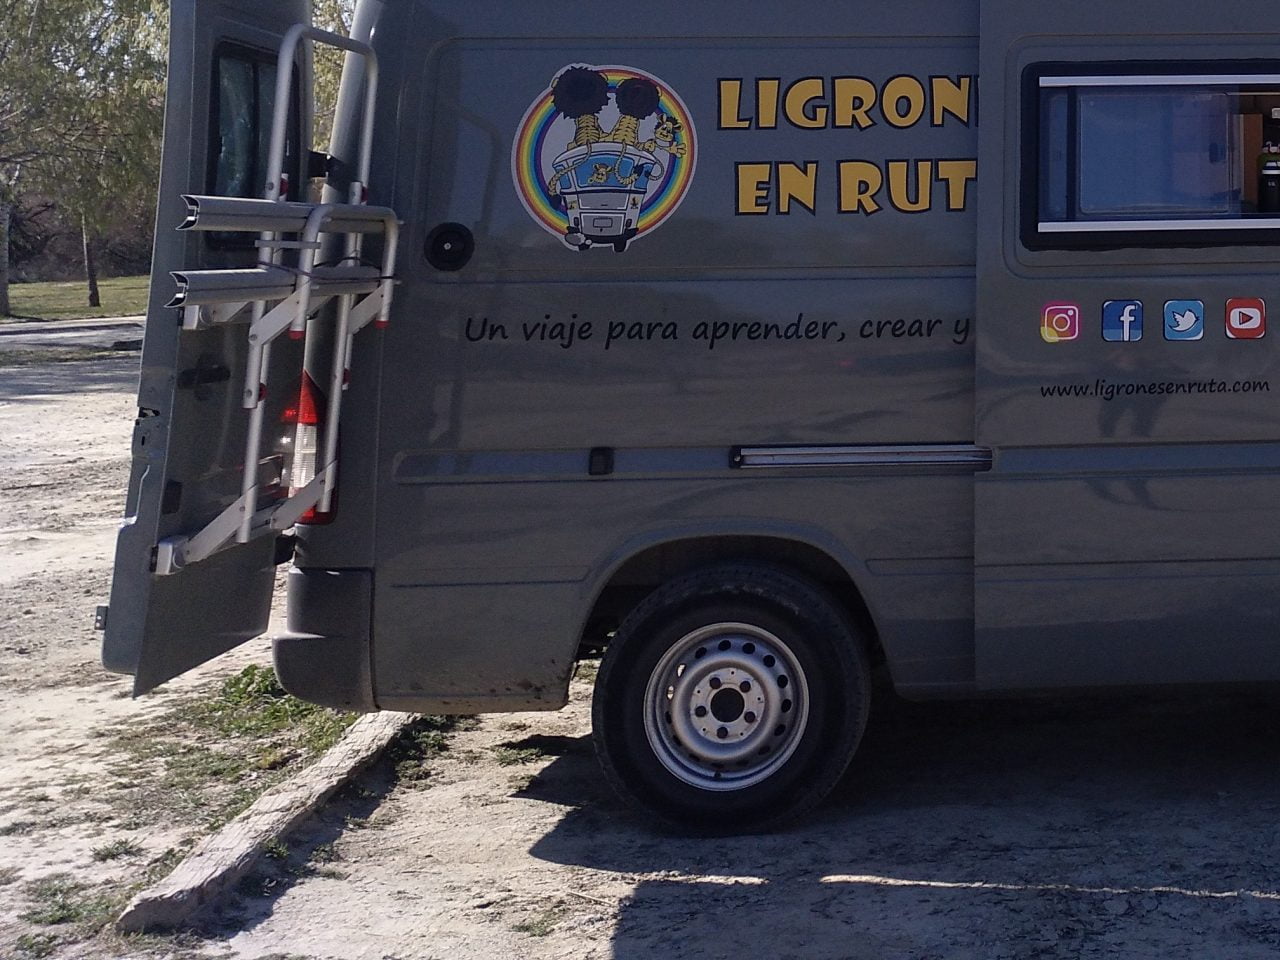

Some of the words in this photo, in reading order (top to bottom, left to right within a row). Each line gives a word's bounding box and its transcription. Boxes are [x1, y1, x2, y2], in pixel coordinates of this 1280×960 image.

[717, 74, 979, 131] LIGRON
[734, 161, 818, 216] EN
[465, 316, 508, 342] Un
[522, 313, 593, 350] viaje
[604, 320, 679, 351] para
[692, 312, 846, 351] aprender,
[859, 318, 943, 339] crear
[953, 317, 971, 345] y
[1040, 378, 1271, 401] www.ligronesenruta.com
